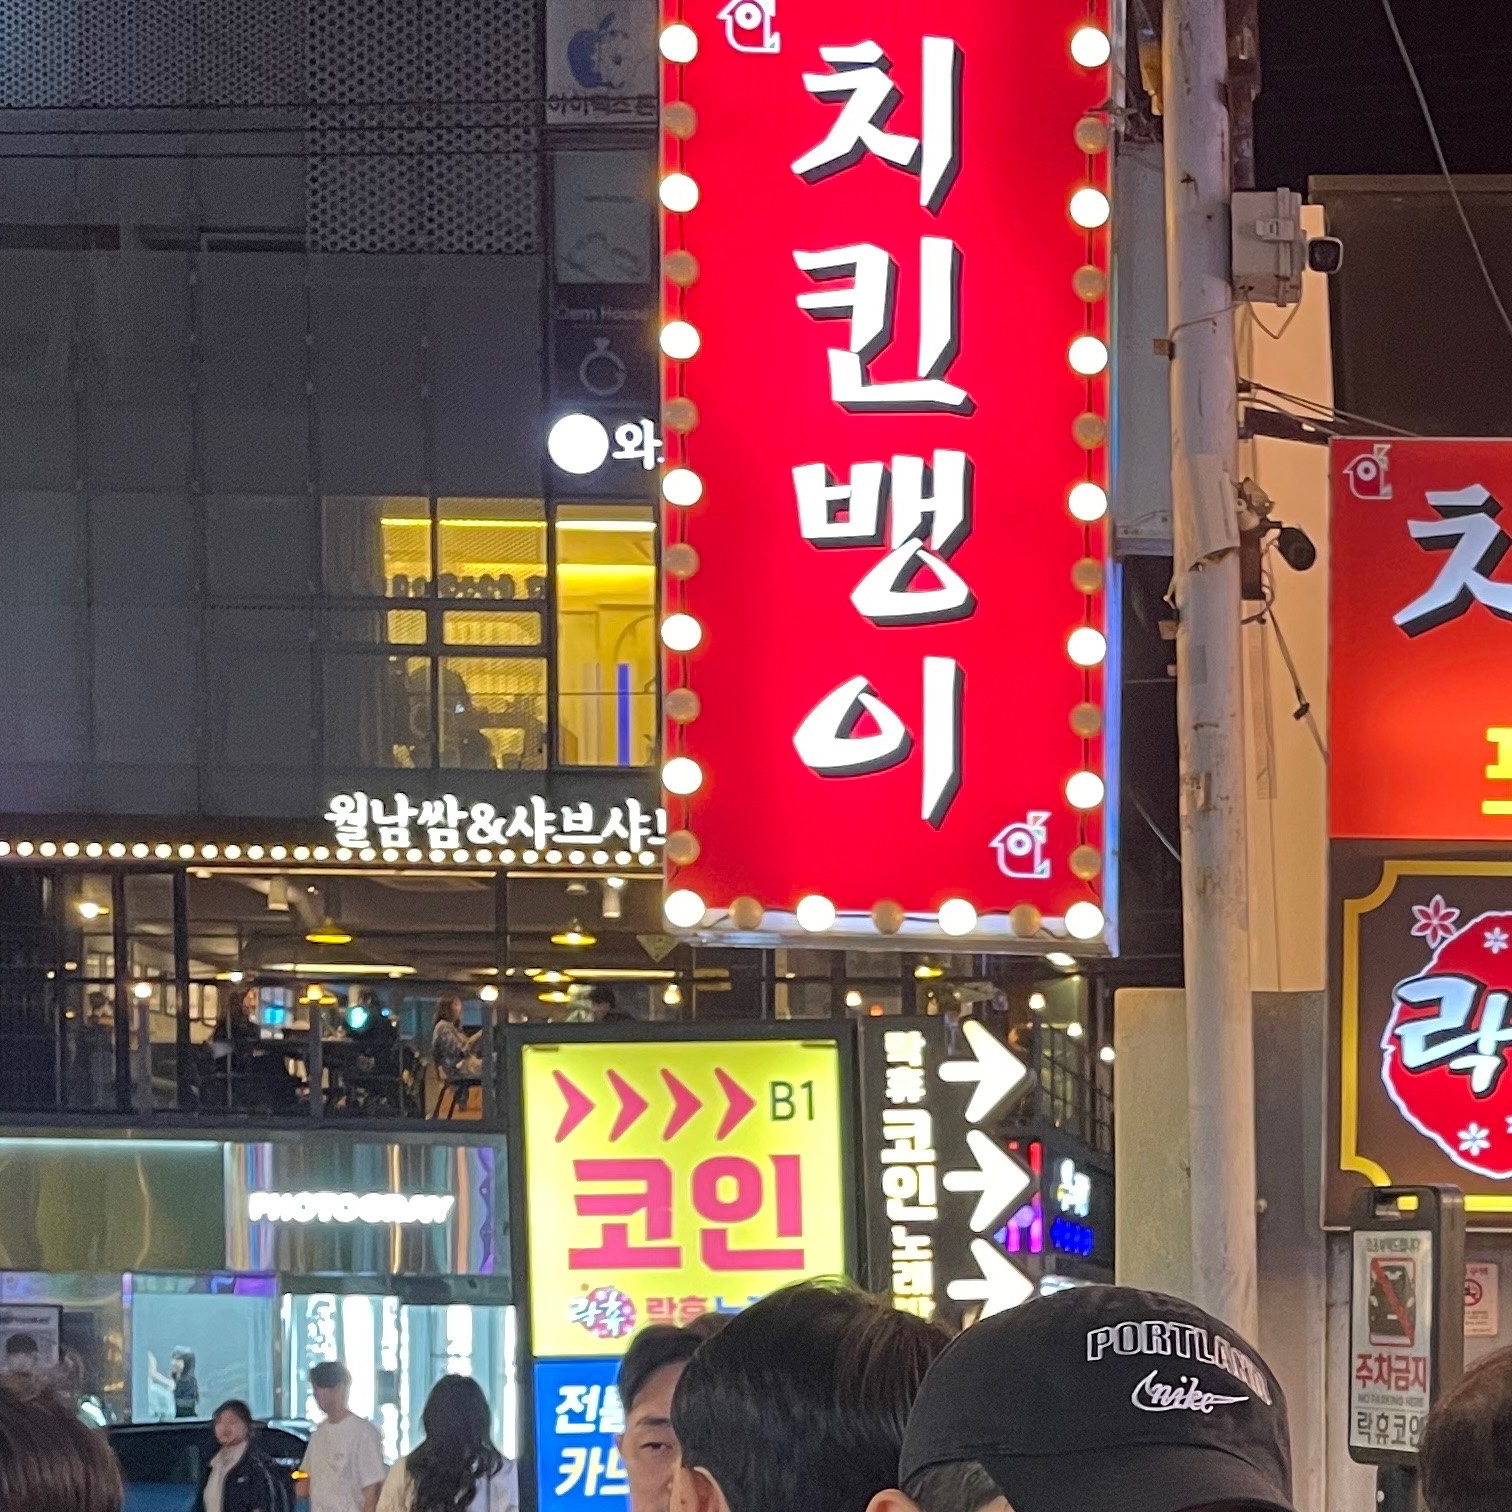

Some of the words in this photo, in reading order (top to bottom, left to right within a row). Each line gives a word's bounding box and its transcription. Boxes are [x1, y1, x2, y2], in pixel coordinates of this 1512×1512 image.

[790, 35, 979, 832] 치킨뱅이
[769, 1080, 815, 1122] B1
[567, 1153, 805, 1272] 코인
[1086, 1320, 1273, 1406] PORTLAND
[1355, 1354, 1428, 1393] 주차금지
